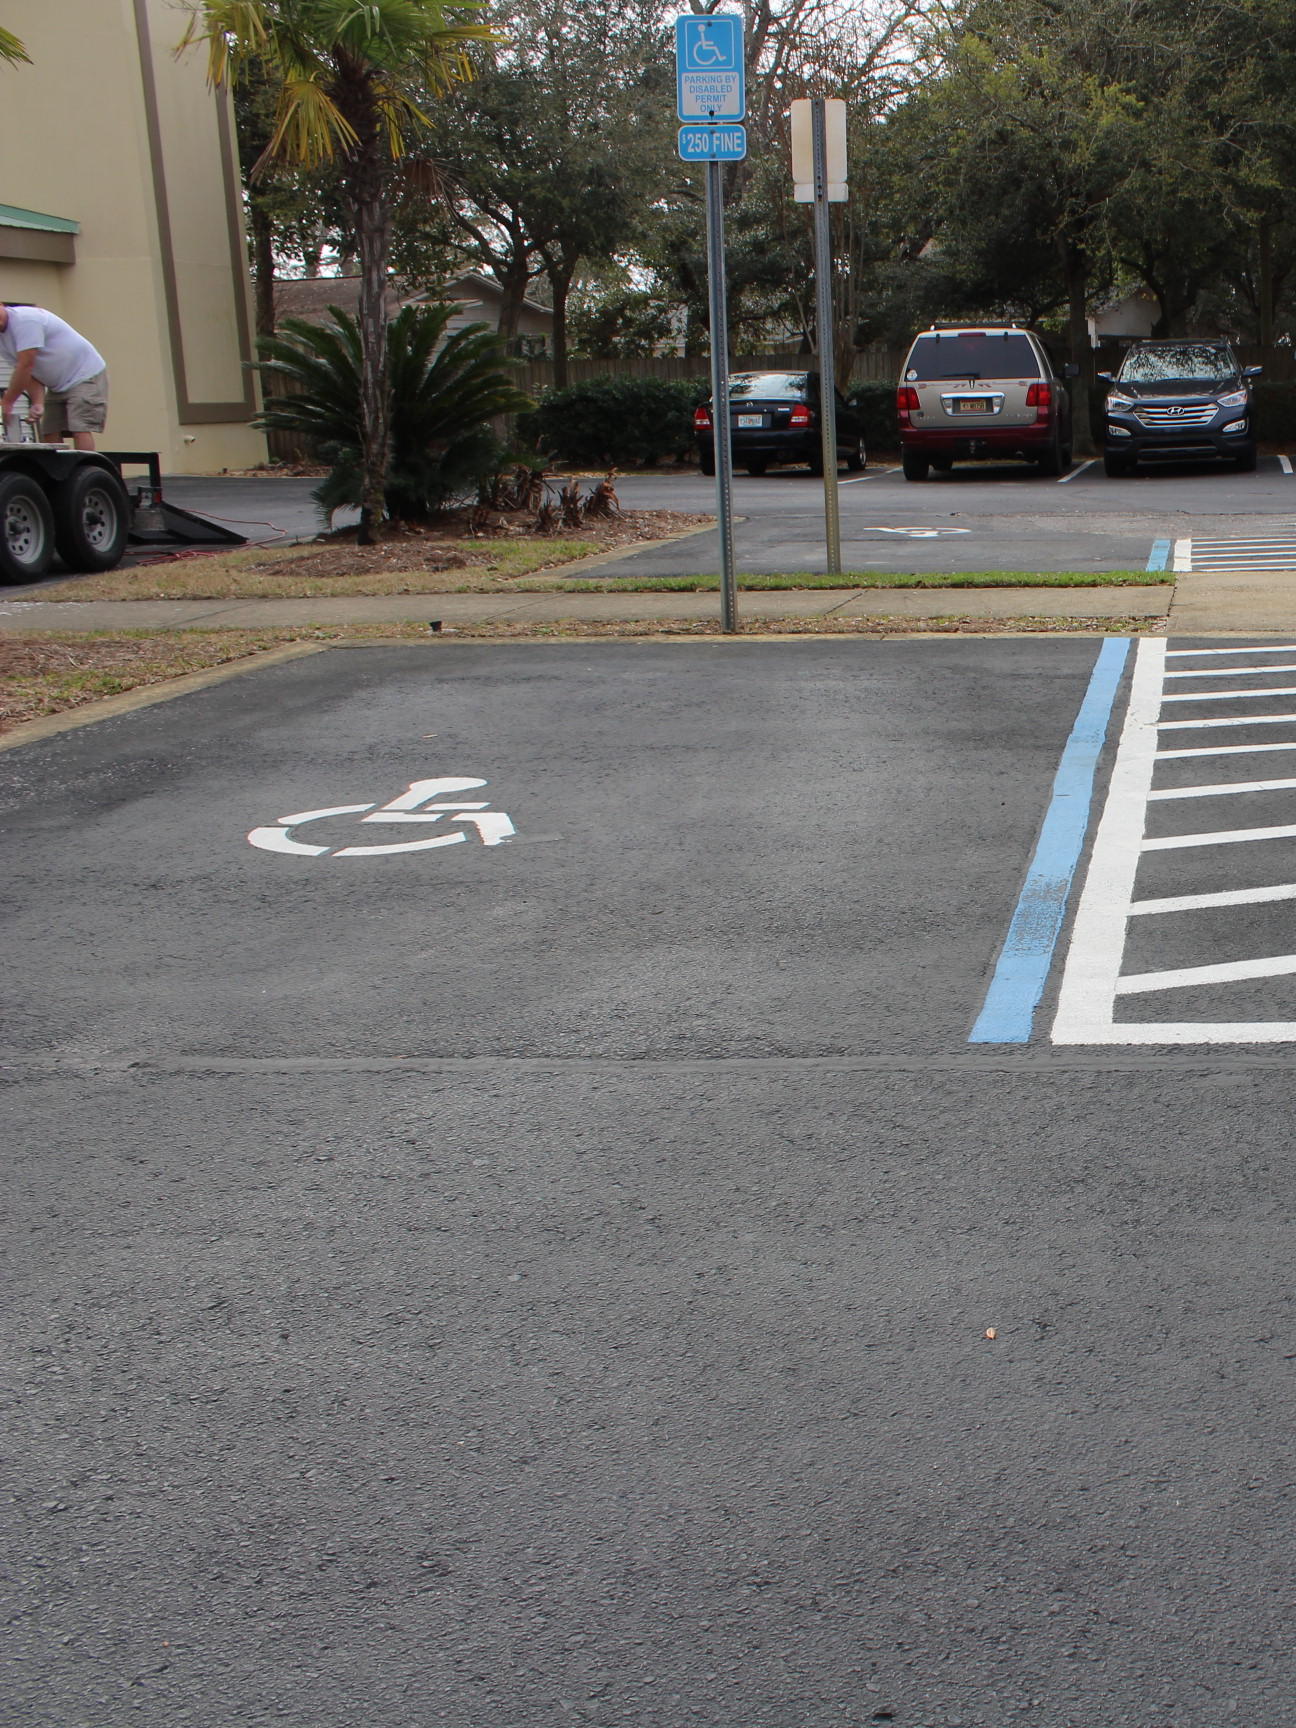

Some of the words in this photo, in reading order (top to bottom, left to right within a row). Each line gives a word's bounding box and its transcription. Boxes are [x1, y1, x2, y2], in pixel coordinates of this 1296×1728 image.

[684, 75, 722, 84] PARKING
[725, 74, 737, 83] BY
[689, 84, 732, 94] DISABLED
[695, 94, 727, 103] PERMIT
[700, 104, 722, 113] ONLY
[682, 132, 709, 153] $250
[713, 131, 742, 152] FINE
